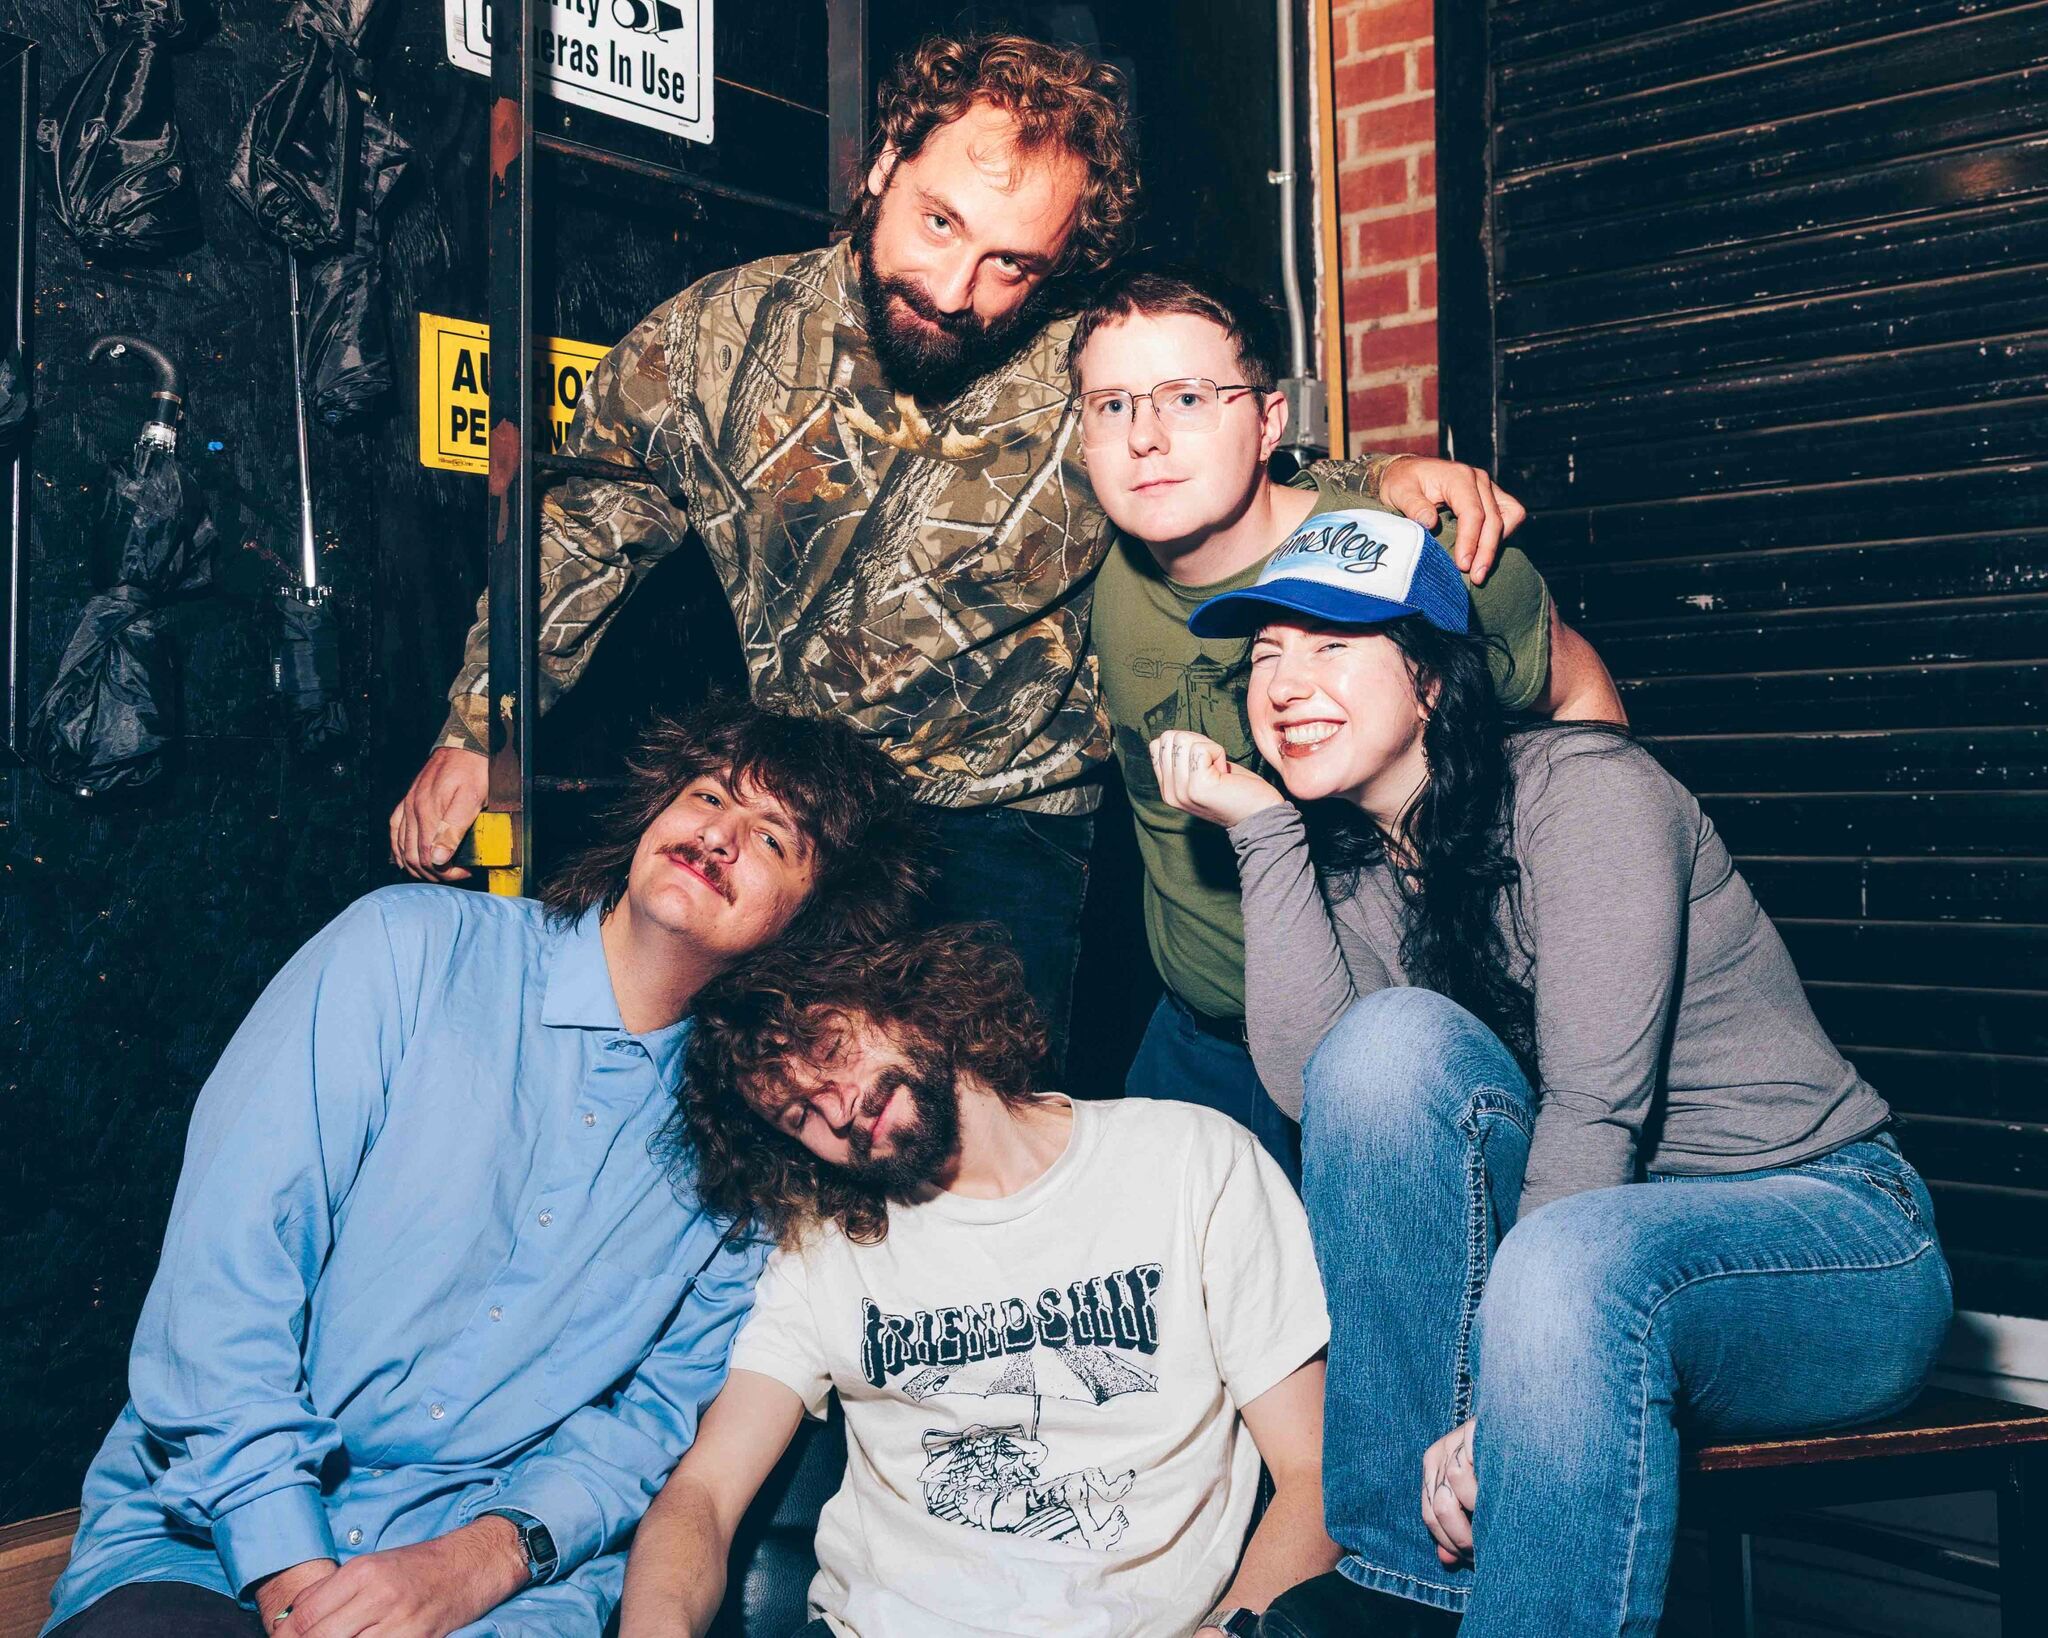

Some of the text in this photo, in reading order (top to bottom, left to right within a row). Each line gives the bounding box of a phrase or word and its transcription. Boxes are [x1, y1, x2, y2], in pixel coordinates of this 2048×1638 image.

[609, 39, 632, 89] In
[642, 49, 685, 104] Use
[861, 1262, 1164, 1388] FRIENDSHIP
